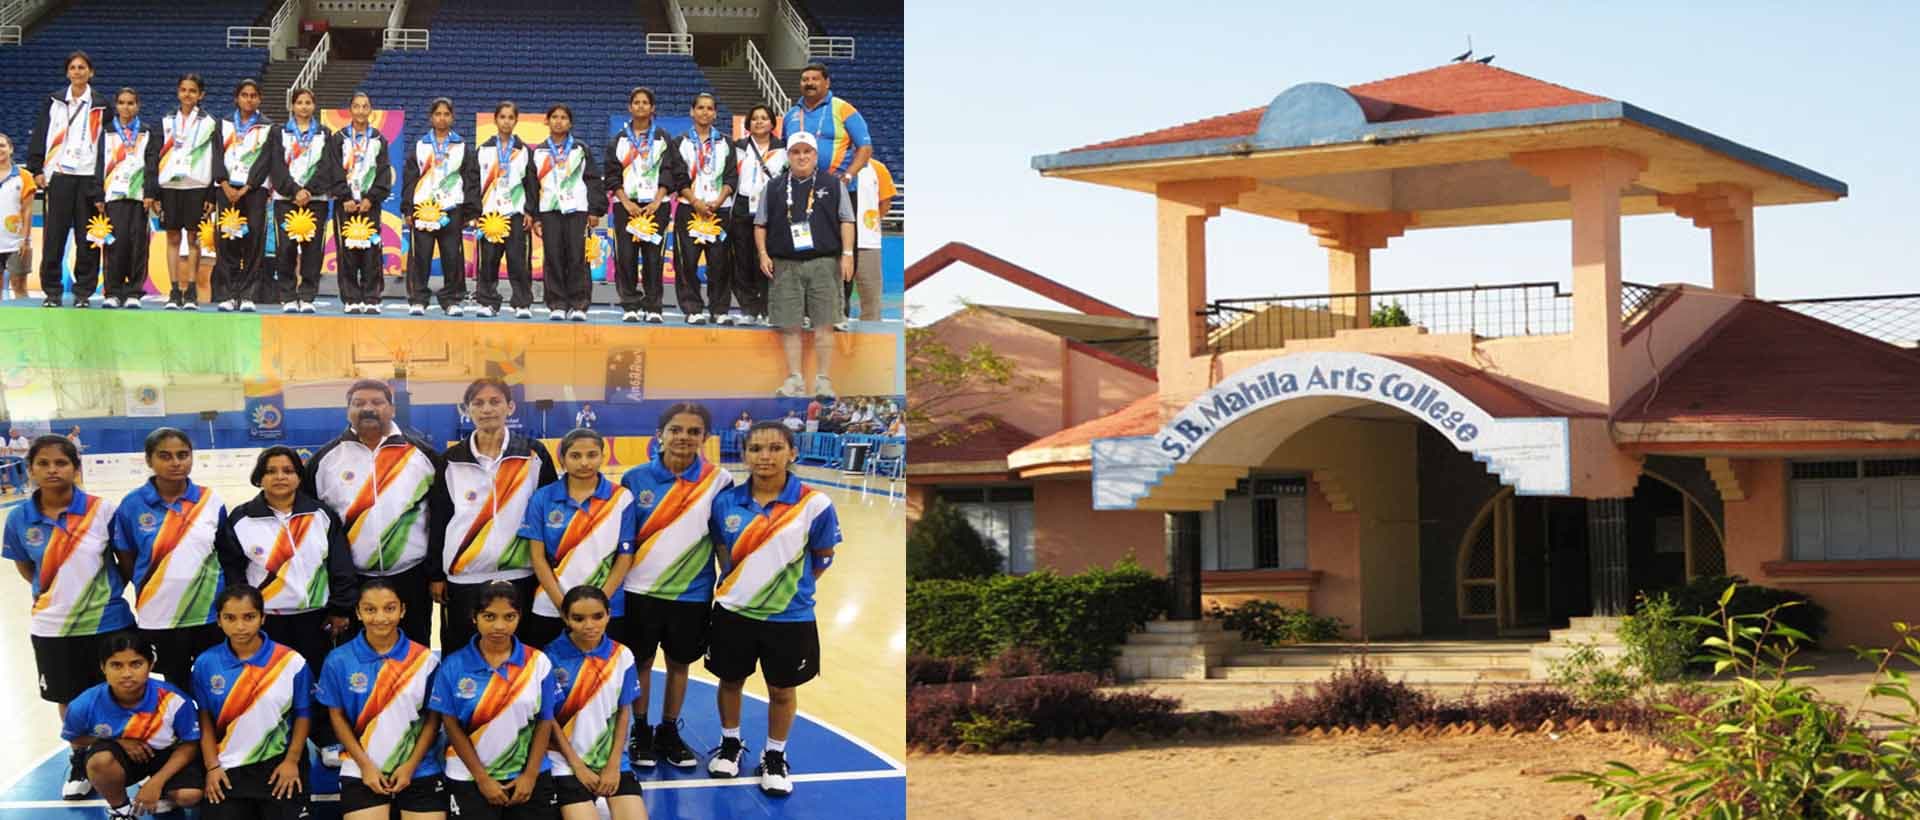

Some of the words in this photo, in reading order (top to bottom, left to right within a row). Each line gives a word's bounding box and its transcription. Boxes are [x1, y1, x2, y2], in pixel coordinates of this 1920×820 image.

[1306, 364, 1375, 393] Arts
[1379, 373, 1479, 443] College
[449, 793, 461, 816] 4
